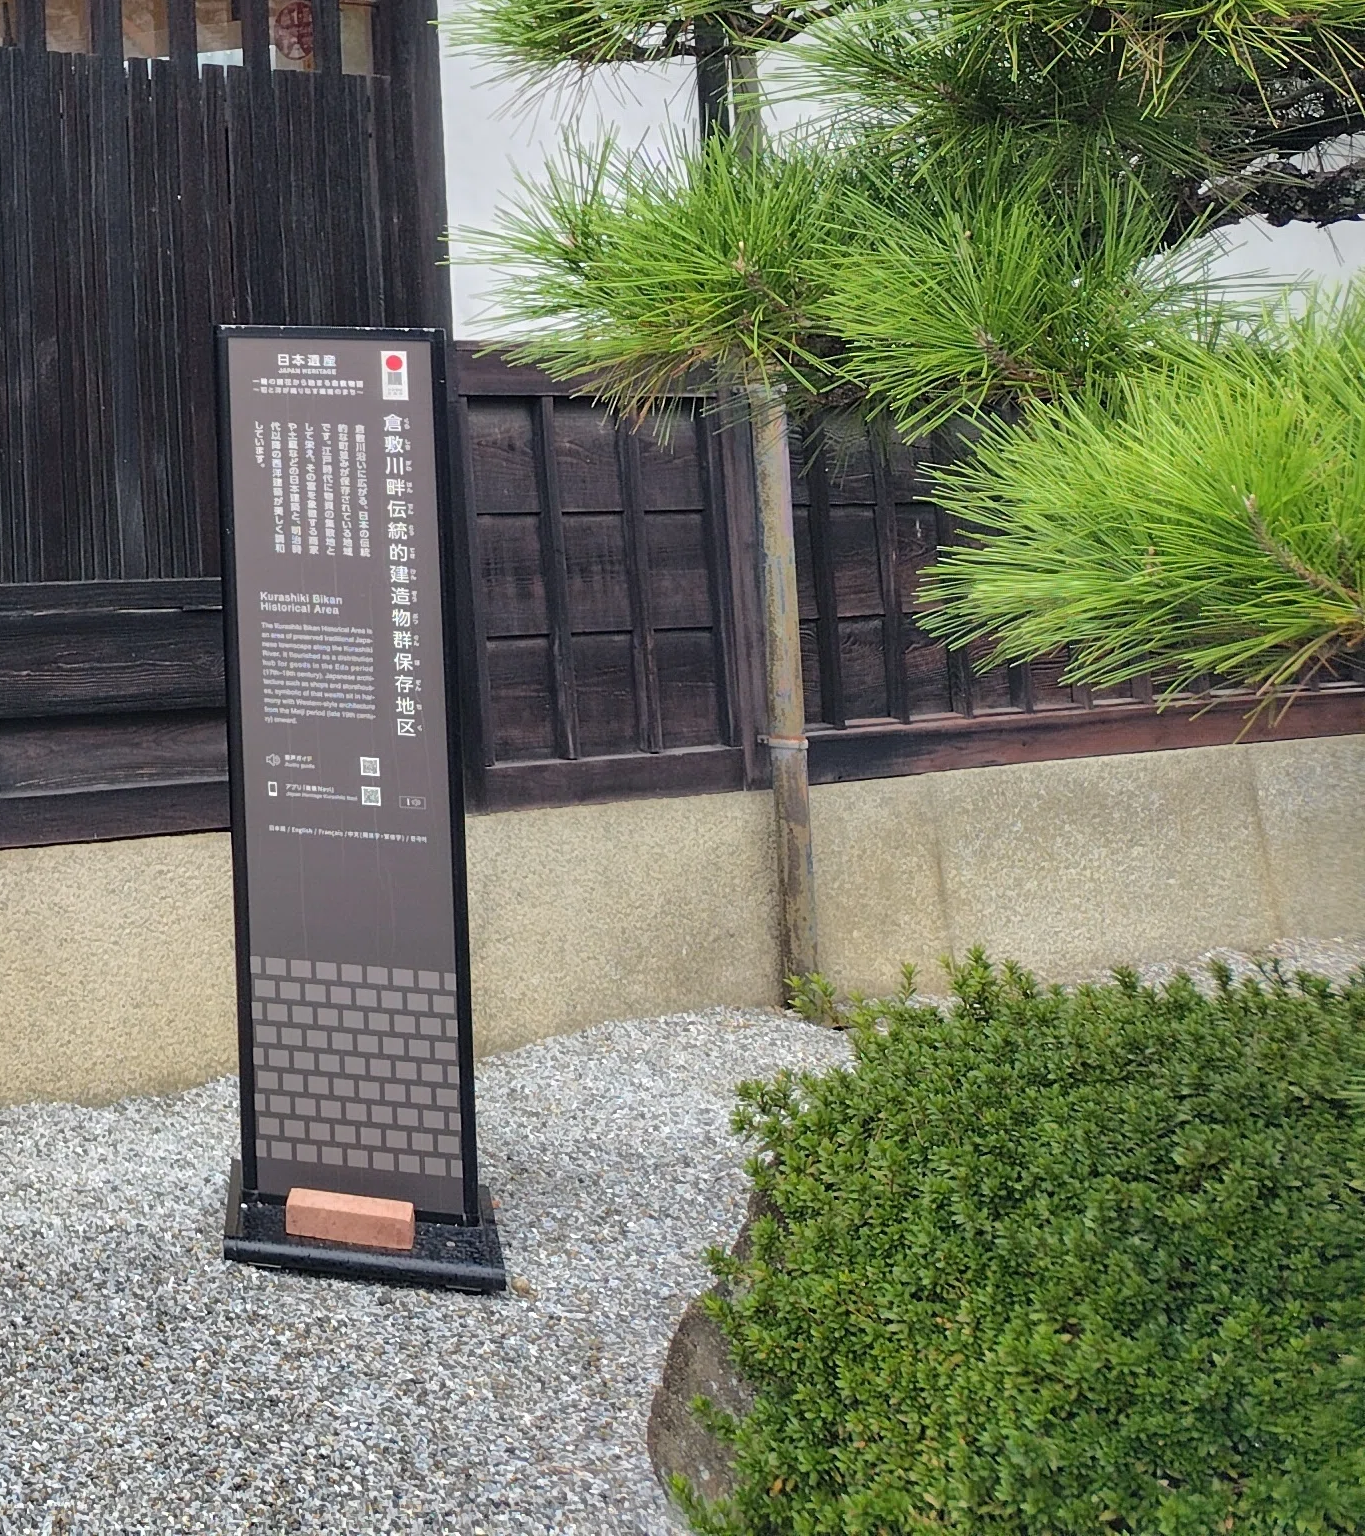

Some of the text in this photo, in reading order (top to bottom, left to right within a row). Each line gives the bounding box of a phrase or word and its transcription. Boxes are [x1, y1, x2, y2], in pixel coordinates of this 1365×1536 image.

[278, 354, 336, 366] 日本遺産
[255, 421, 265, 468] しています。
[383, 414, 416, 737] 倉敷川畔伝統的建造物群保存地区
[260, 592, 342, 604] Kurashiki Bikan
[260, 602, 339, 614] Historical Area
